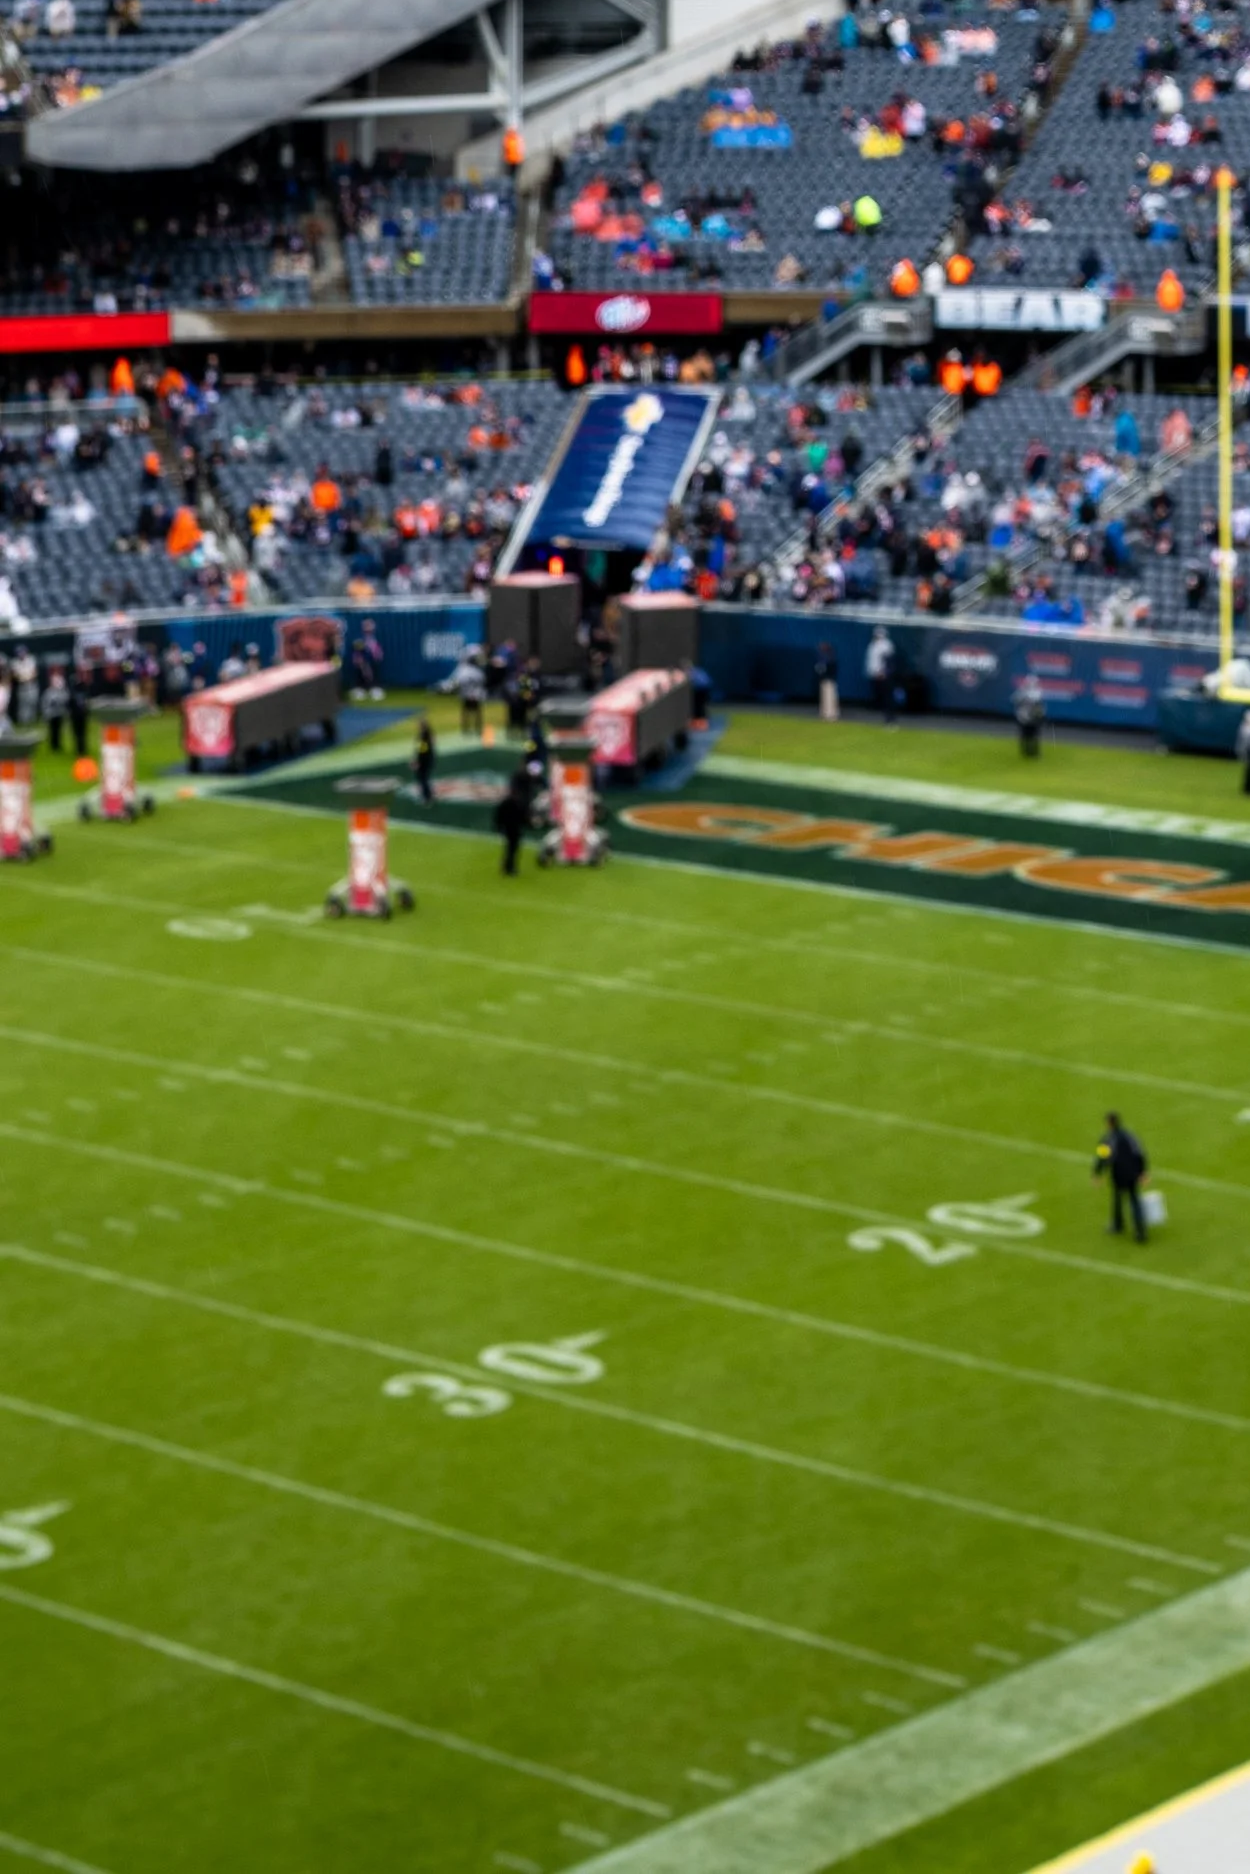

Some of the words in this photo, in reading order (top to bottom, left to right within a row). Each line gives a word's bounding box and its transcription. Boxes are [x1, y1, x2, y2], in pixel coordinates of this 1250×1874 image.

[936, 290, 1104, 331] BEAR
[847, 1199, 1046, 1265] 20
[382, 1340, 606, 1419] 30
